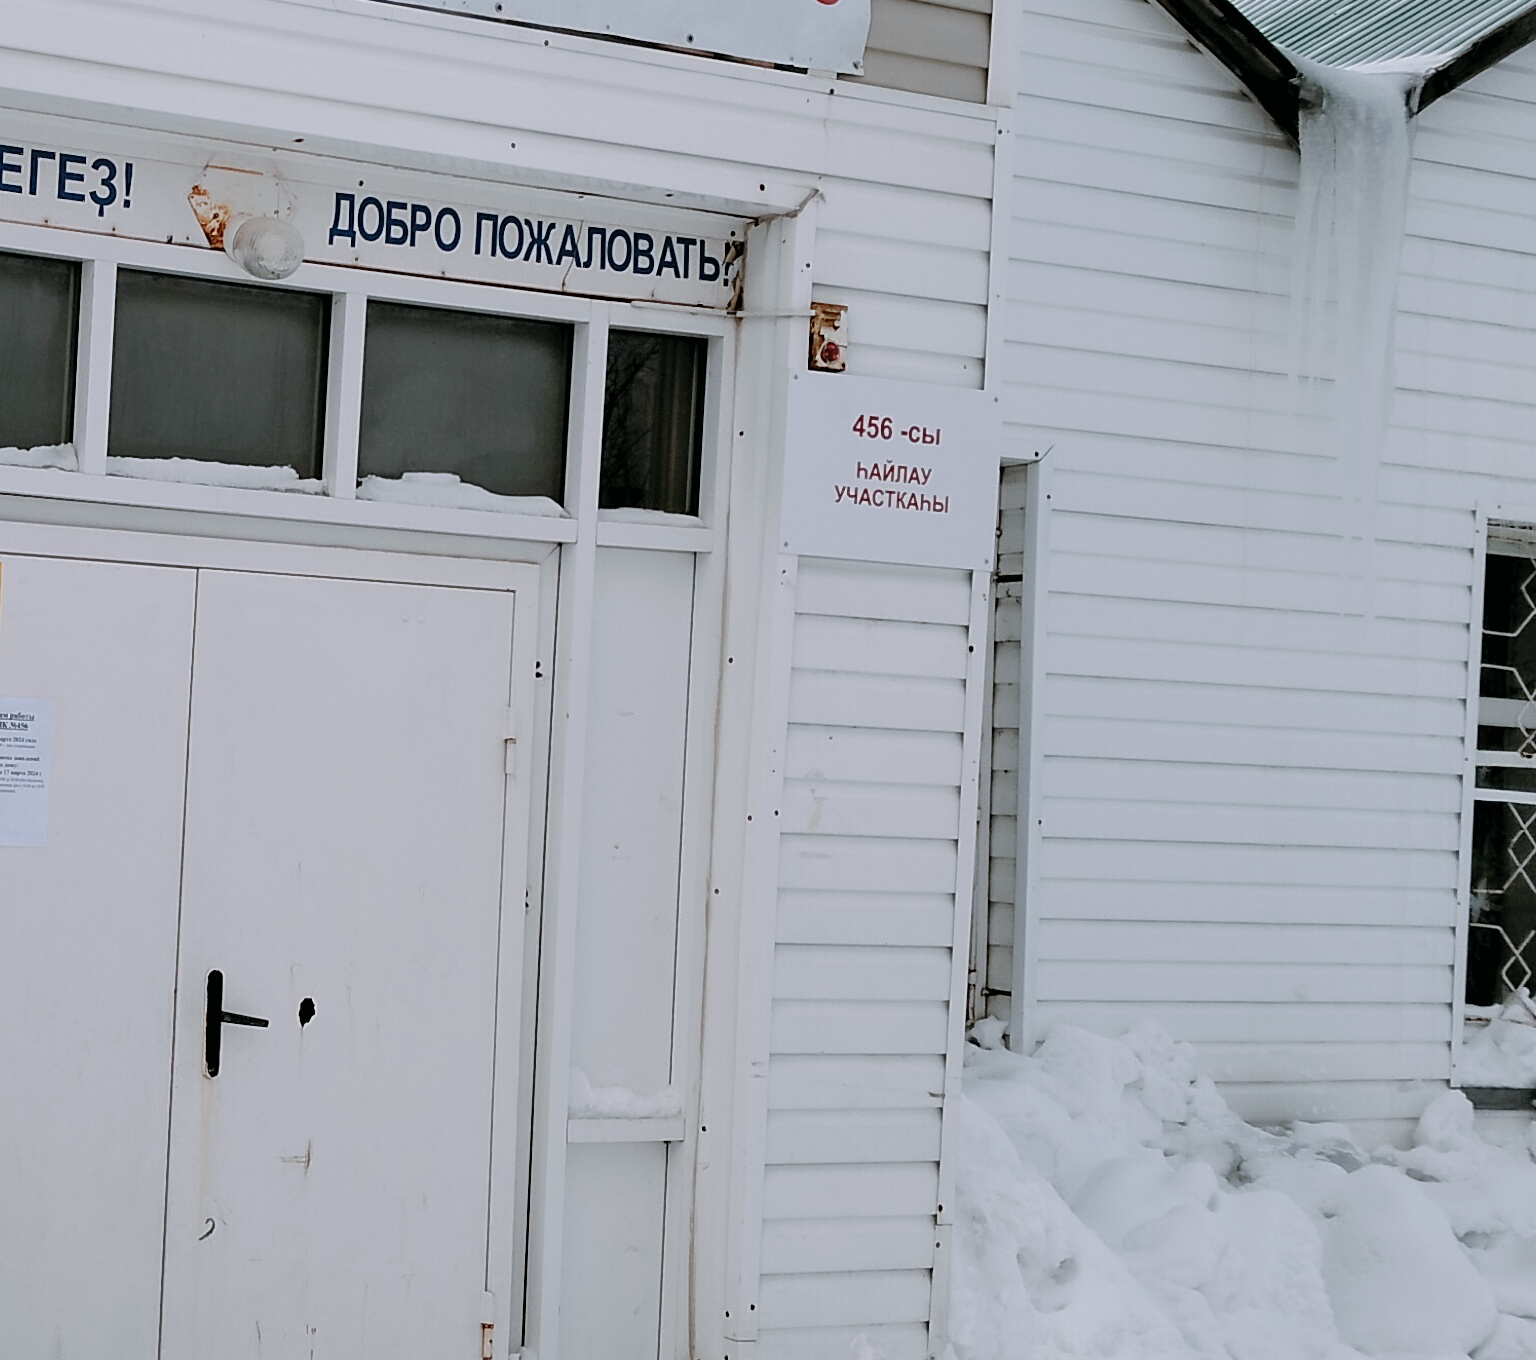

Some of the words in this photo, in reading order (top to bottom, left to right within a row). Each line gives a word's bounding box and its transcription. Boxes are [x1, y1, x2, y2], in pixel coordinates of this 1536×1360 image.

[330, 192, 461, 253] ДОБРО
[474, 209, 734, 288] ПОЖАЛОВАТЬ!
[852, 414, 893, 440] 456
[856, 459, 932, 485] ҺАЙЛАУ
[834, 485, 949, 513] УЧАСТКАҺЫ
